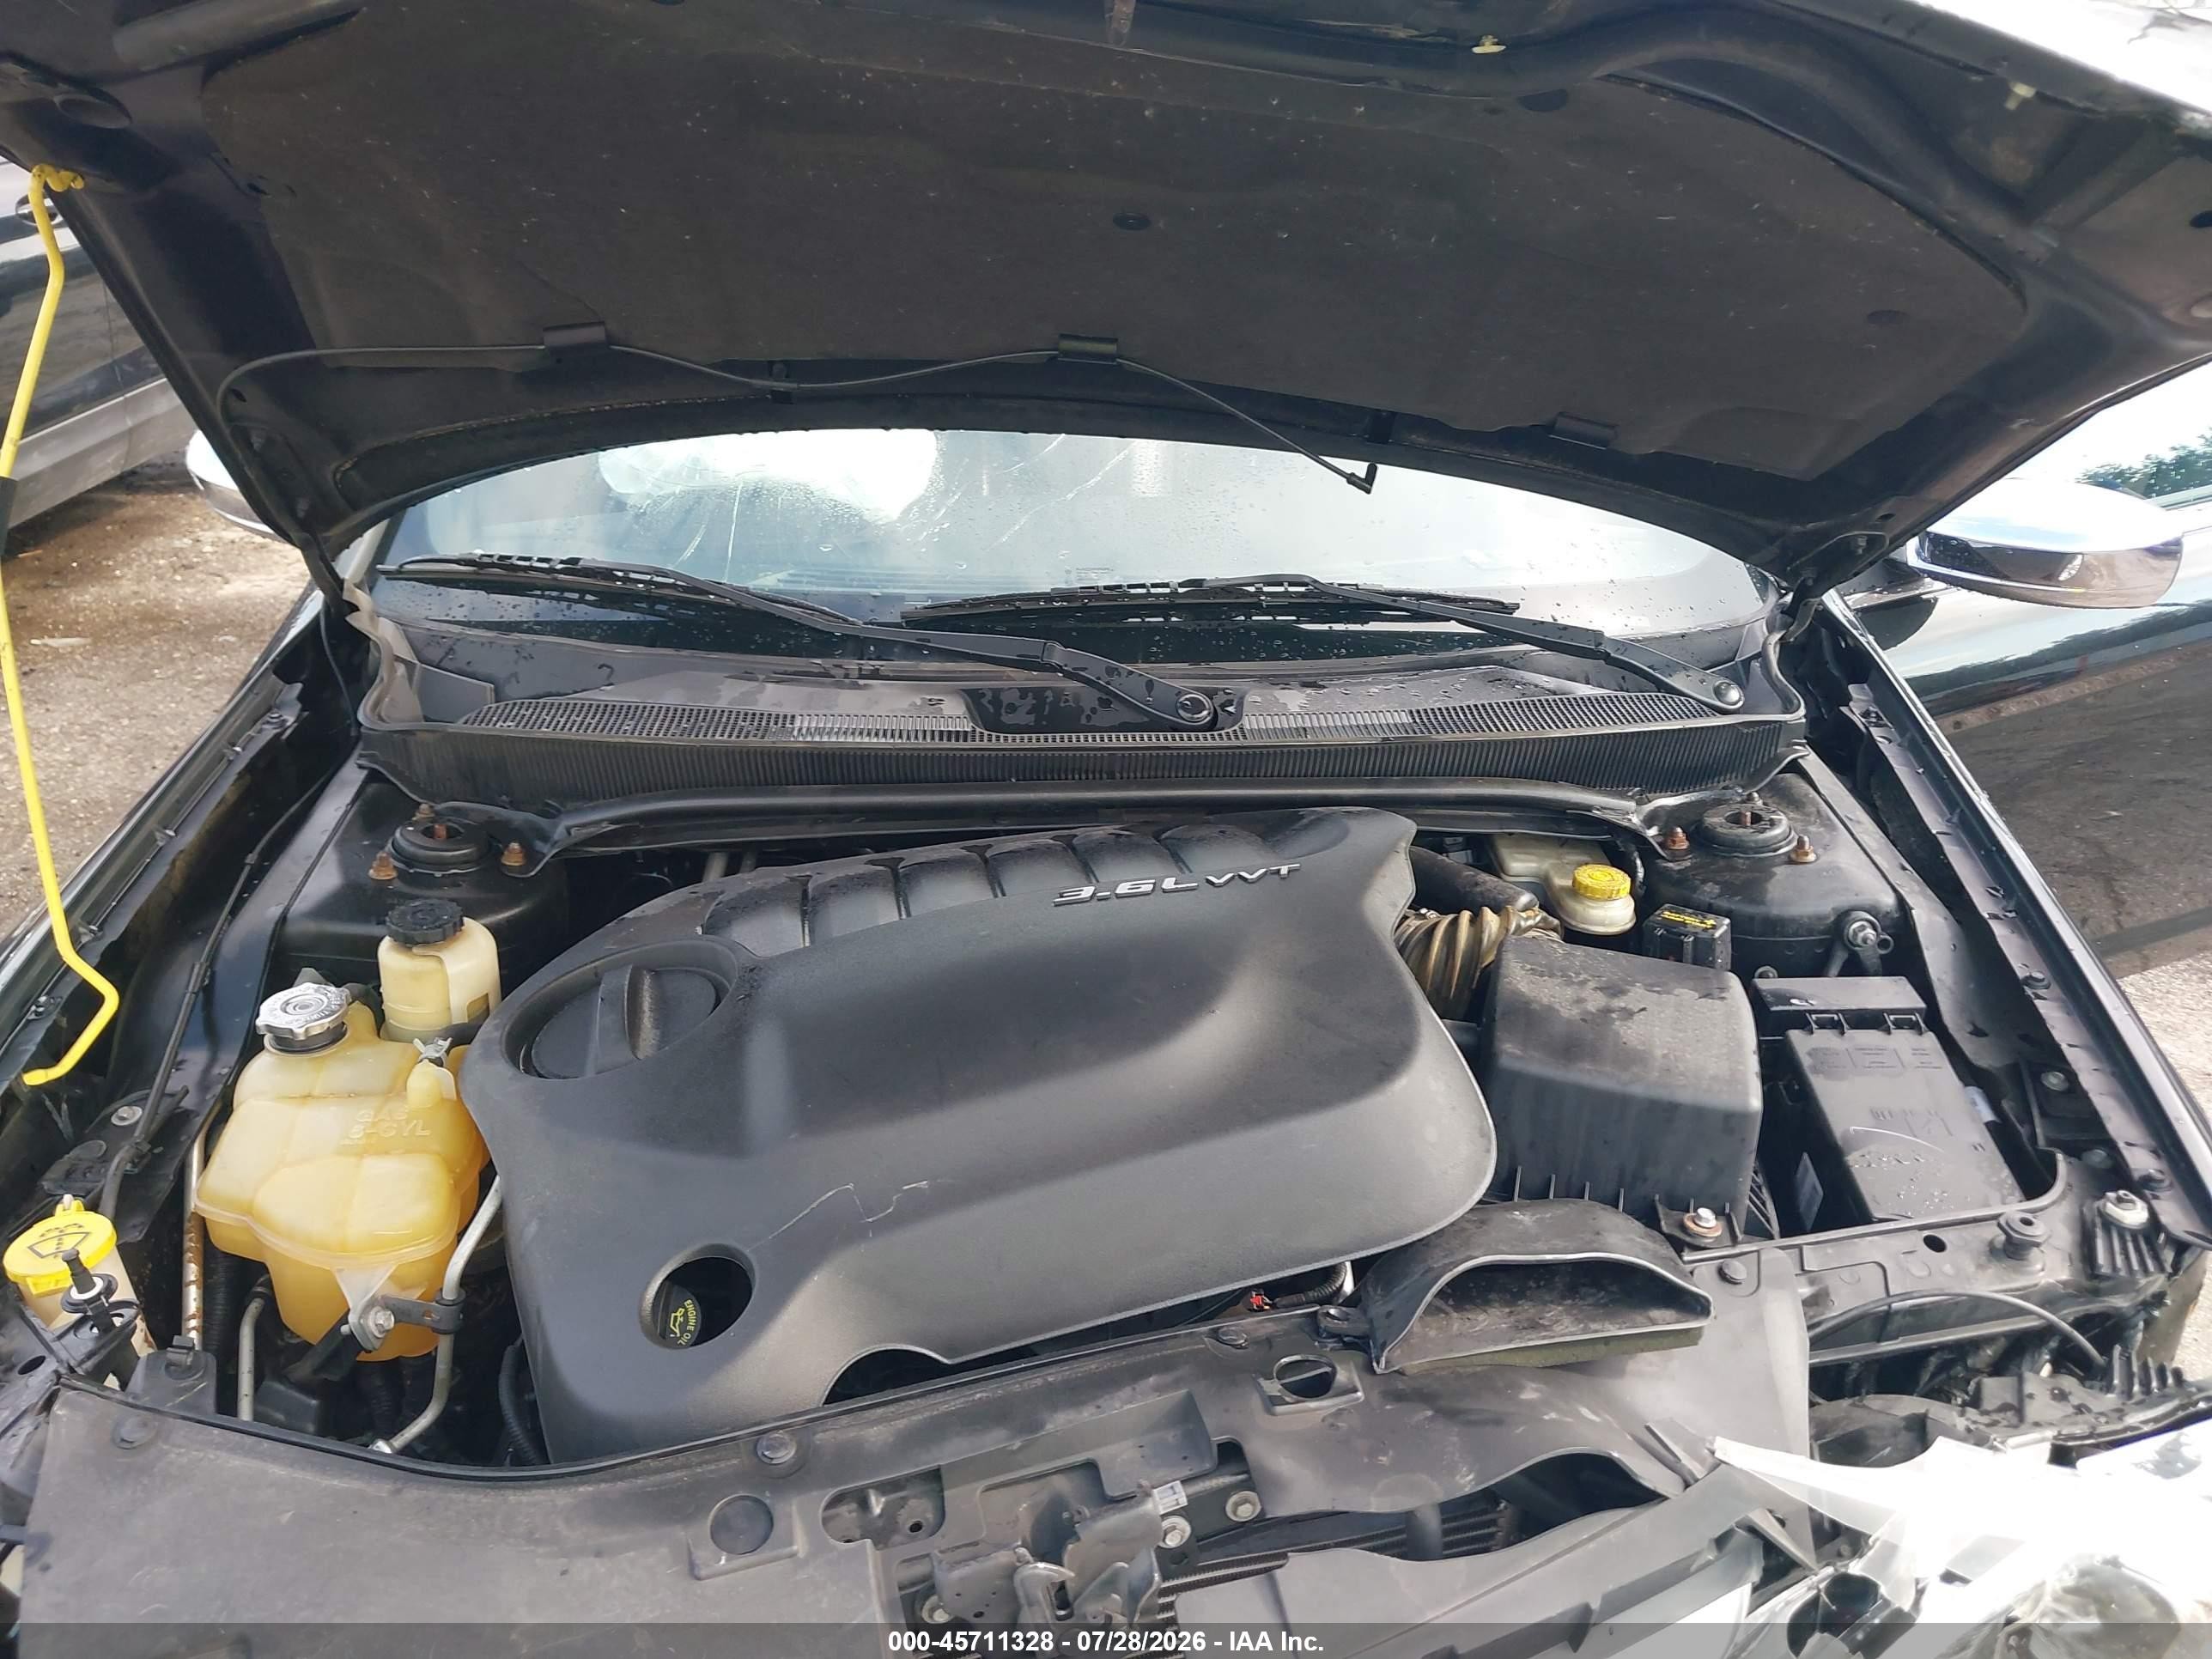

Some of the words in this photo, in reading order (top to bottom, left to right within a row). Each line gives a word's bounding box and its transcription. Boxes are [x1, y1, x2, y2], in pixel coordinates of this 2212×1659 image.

[1053, 876, 1200, 907] 3.6L
[1206, 863, 1302, 888] VVT
[684, 1299, 697, 1332] ENGINE
[678, 1333, 692, 1346] OIL
